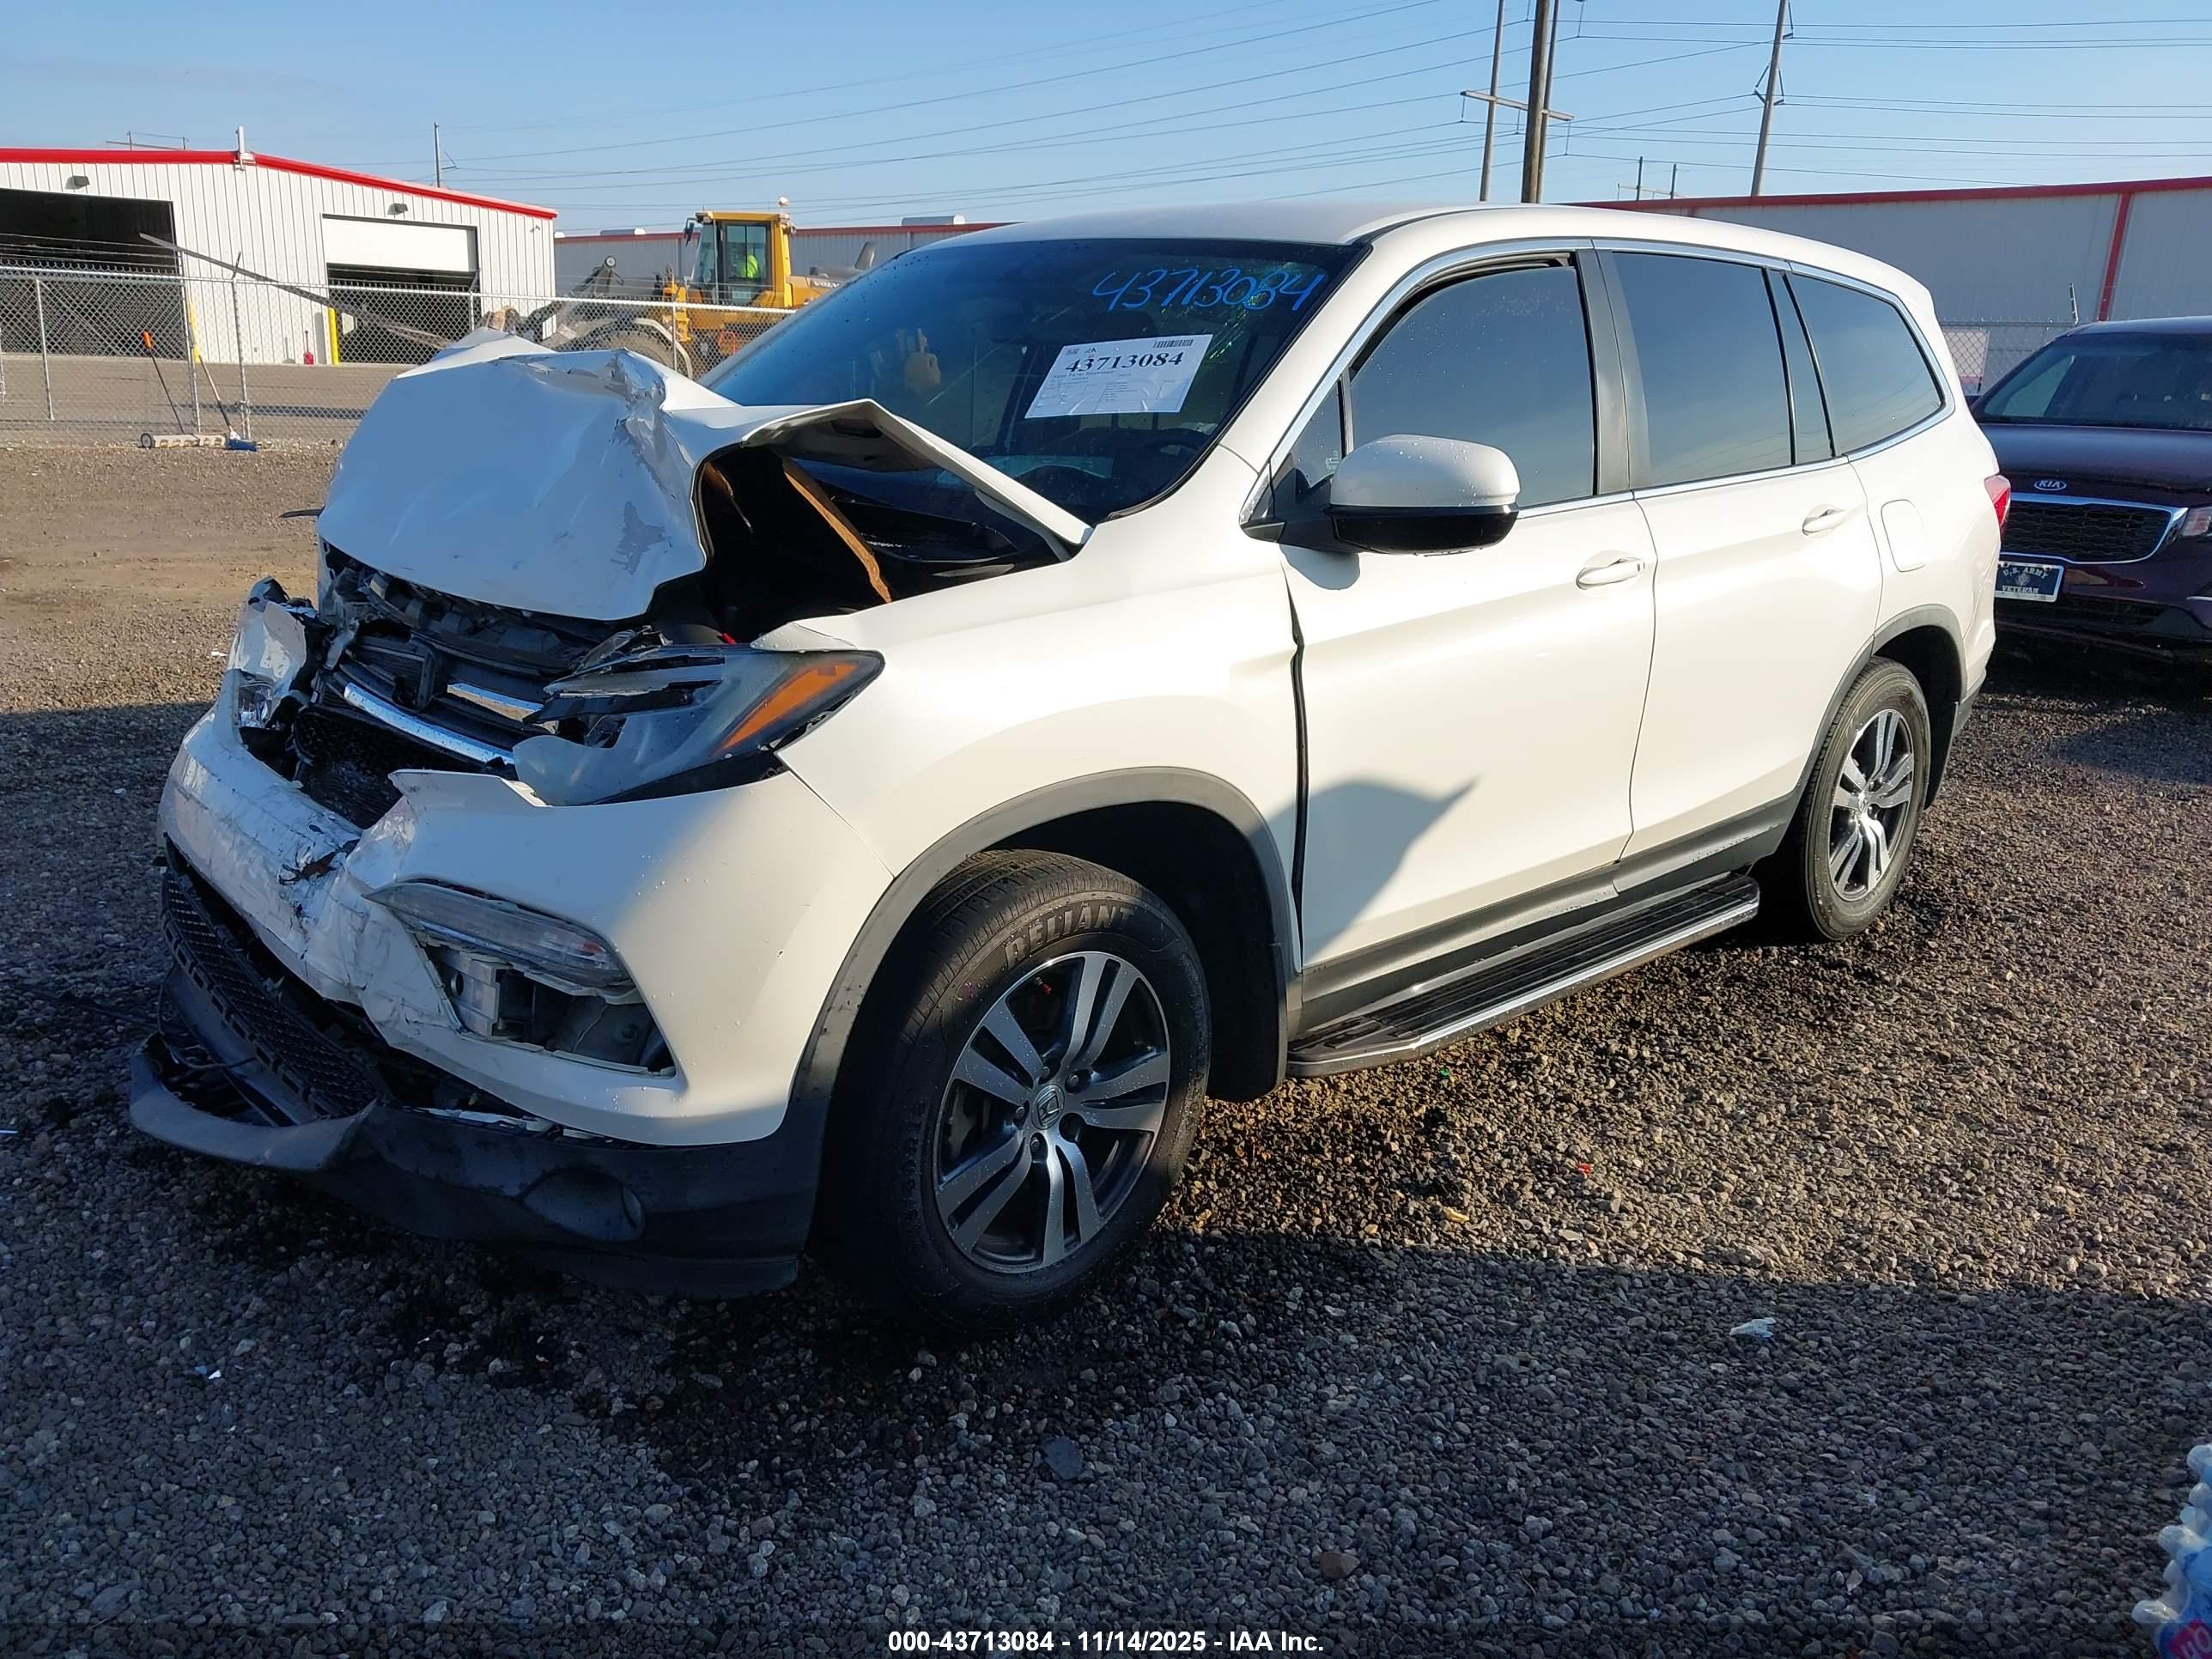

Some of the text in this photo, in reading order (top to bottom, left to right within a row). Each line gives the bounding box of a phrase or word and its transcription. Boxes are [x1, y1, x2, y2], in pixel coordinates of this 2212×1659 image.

[1091, 267, 1325, 313] 43713084
[1066, 351, 1184, 373] 43713084
[2039, 480, 2060, 489] KIA
[2023, 567, 2049, 580] ARMY
[2002, 585, 2039, 594] VETERAN
[1005, 903, 1137, 970] RELIANT
